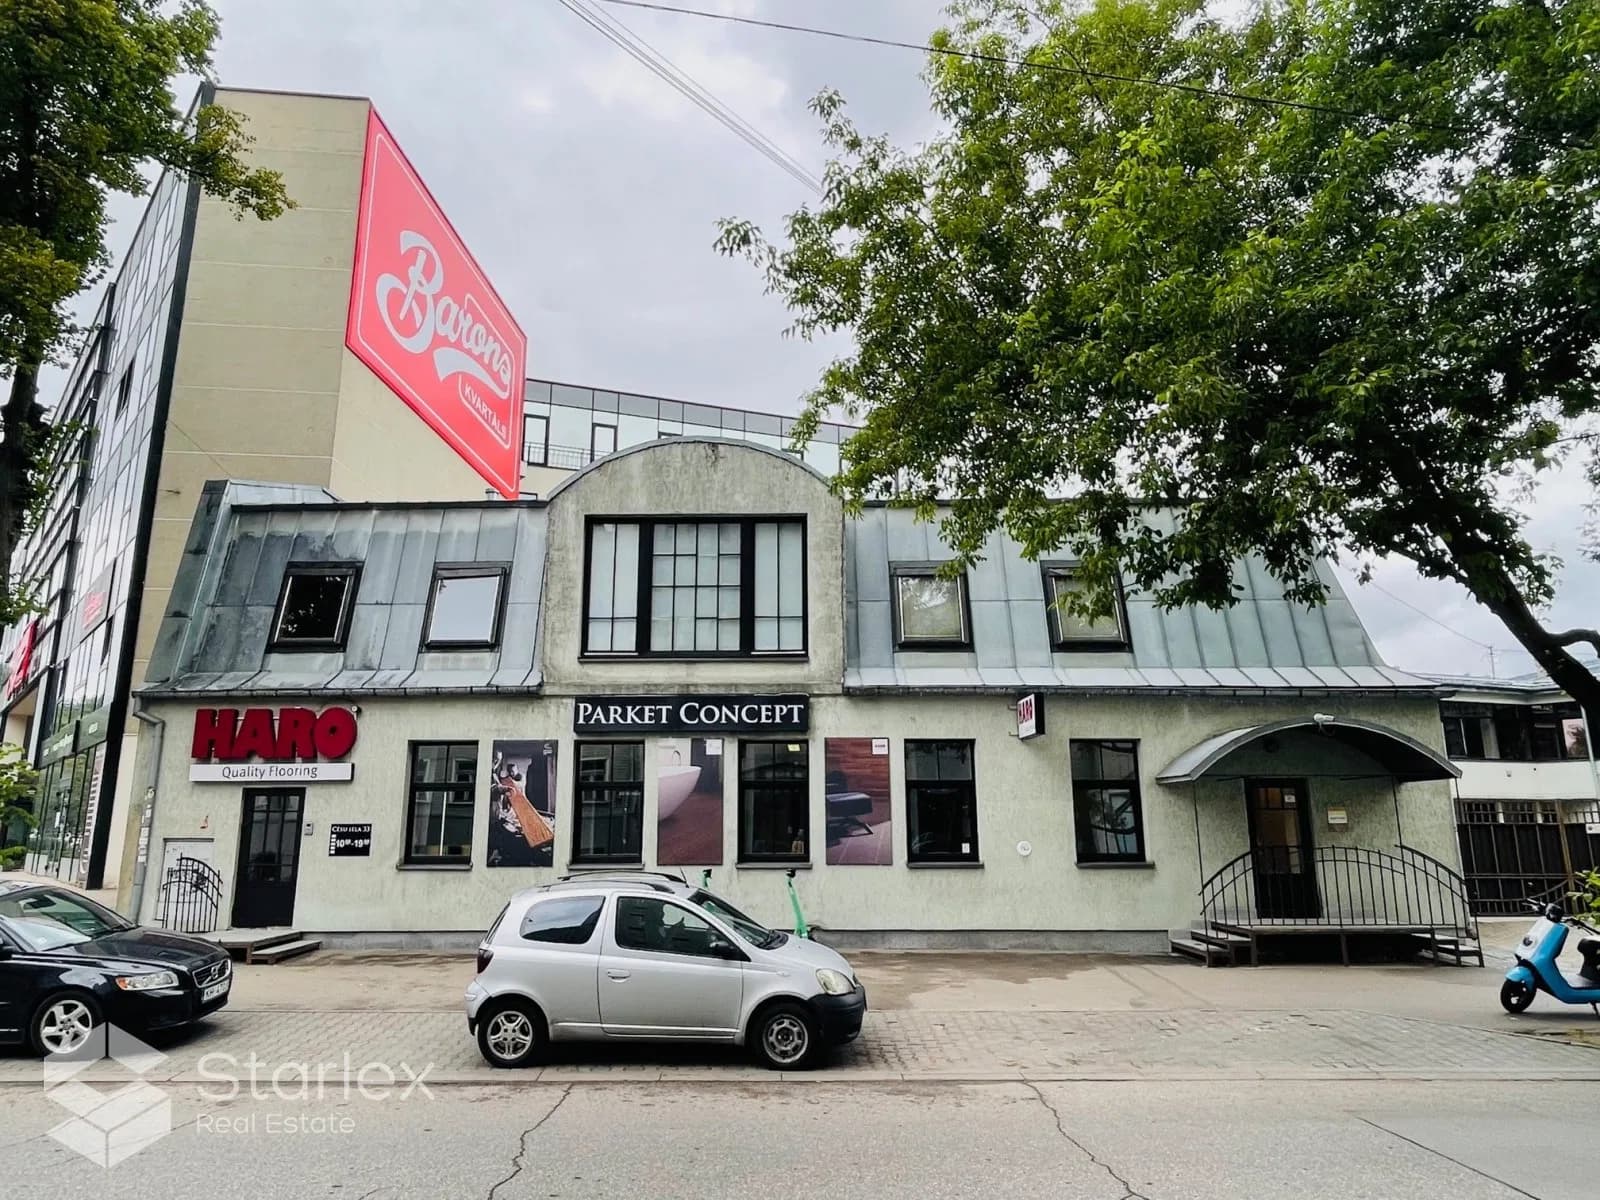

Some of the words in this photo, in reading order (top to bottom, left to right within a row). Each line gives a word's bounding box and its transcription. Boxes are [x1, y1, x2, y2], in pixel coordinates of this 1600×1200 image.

[375, 230, 512, 399] Barona
[577, 703, 672, 725] PARKET
[679, 702, 804, 724] CONCEPT
[191, 707, 358, 761] HARO
[222, 766, 265, 779] Quality
[269, 765, 318, 779] Flooring
